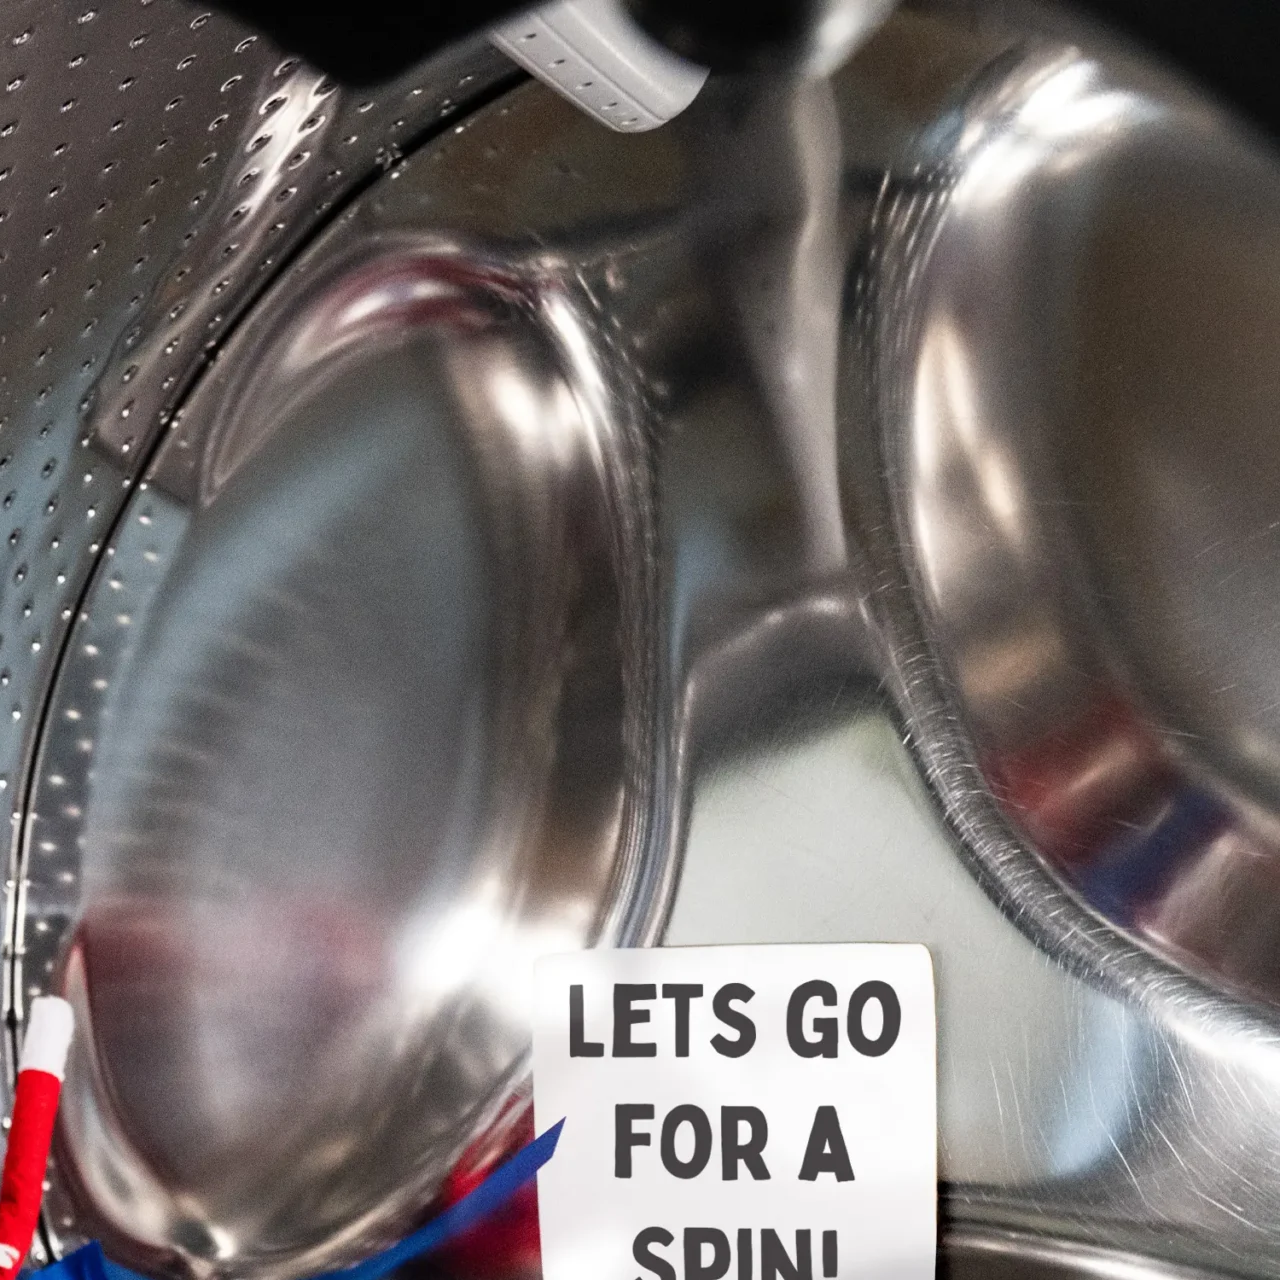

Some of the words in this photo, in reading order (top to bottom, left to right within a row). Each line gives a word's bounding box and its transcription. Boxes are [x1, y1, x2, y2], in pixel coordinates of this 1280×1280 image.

[569, 983, 757, 1059] LETS
[786, 979, 902, 1059] GO
[614, 1103, 771, 1181] FOR
[798, 1105, 855, 1182] A
